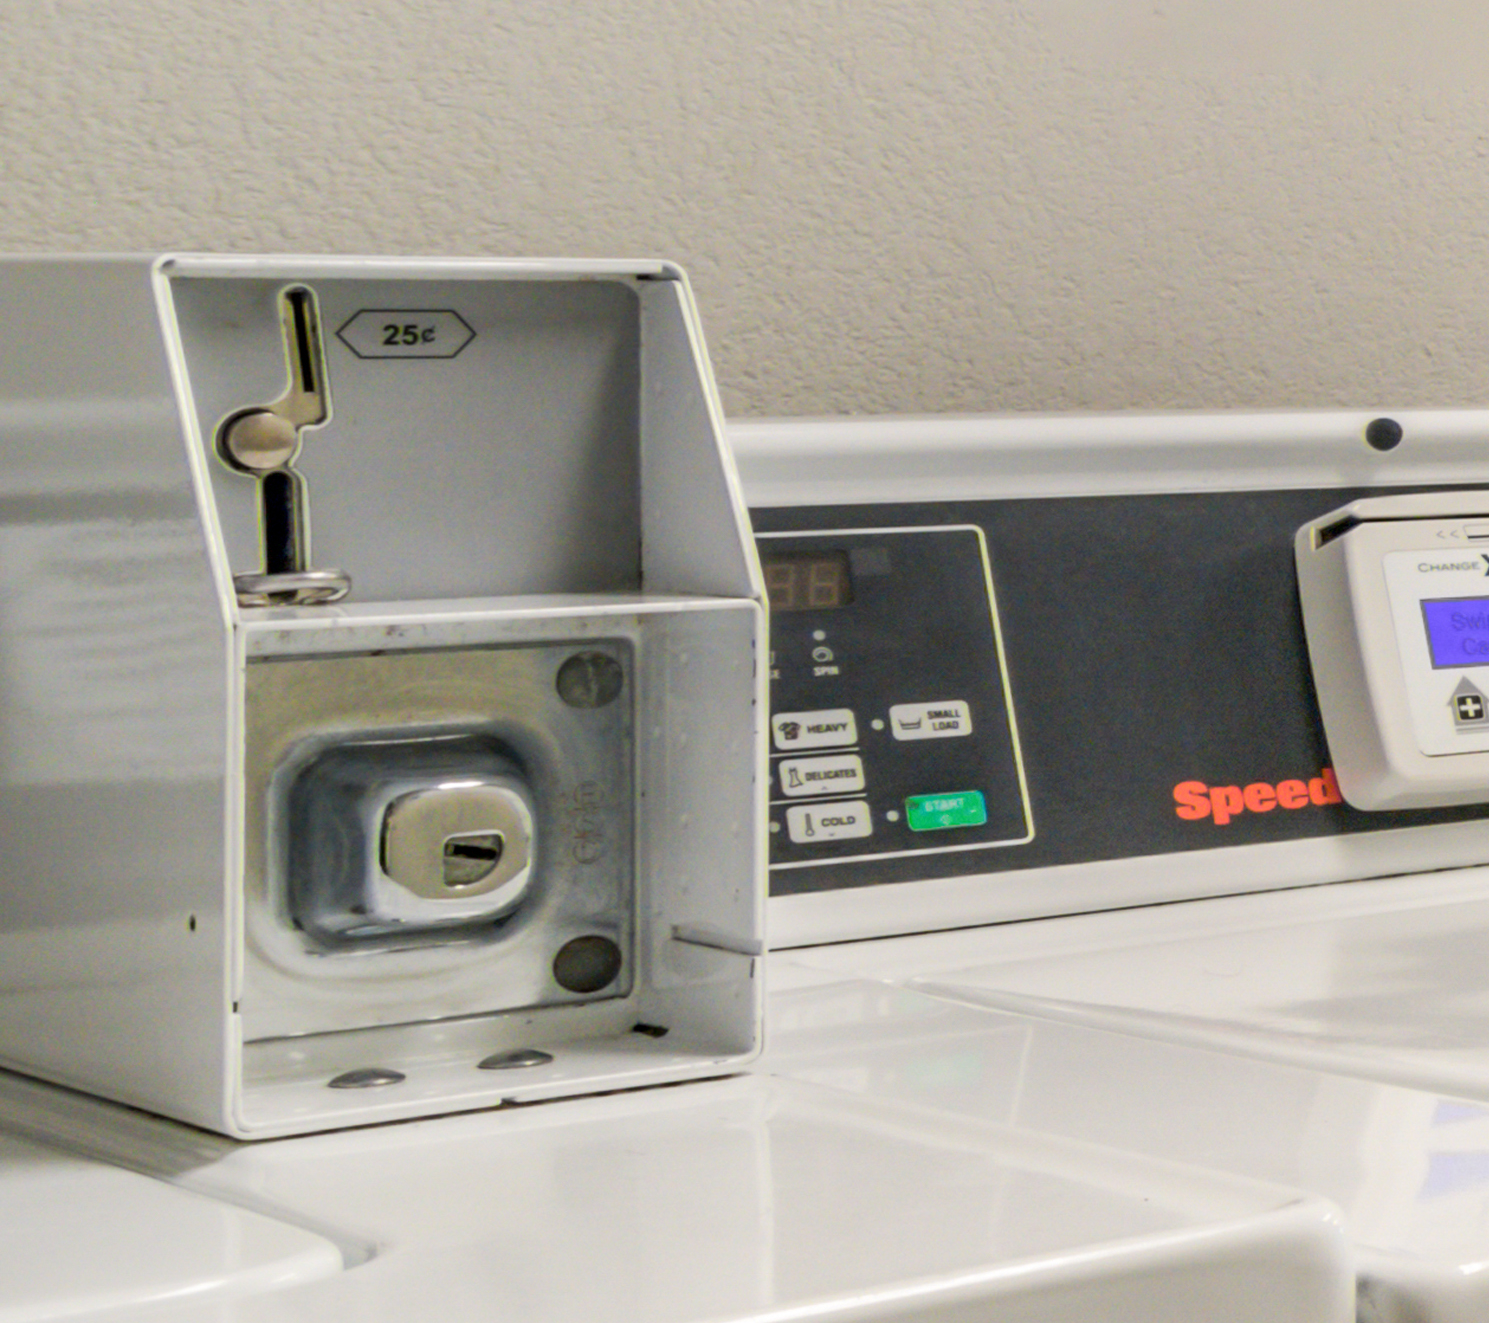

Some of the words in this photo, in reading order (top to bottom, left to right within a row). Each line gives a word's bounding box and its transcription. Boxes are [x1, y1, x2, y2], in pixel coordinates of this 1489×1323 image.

[383, 323, 436, 346] 25¢
[1417, 561, 1481, 573] CHANGE
[813, 665, 840, 677] SPIN
[926, 709, 961, 720] SMALL
[807, 722, 848, 734] HEAVY
[932, 719, 960, 732] LOAD
[805, 768, 857, 782] DELICATES
[1173, 767, 1342, 825] Speed
[925, 797, 965, 813] START
[821, 815, 856, 828] COLD
